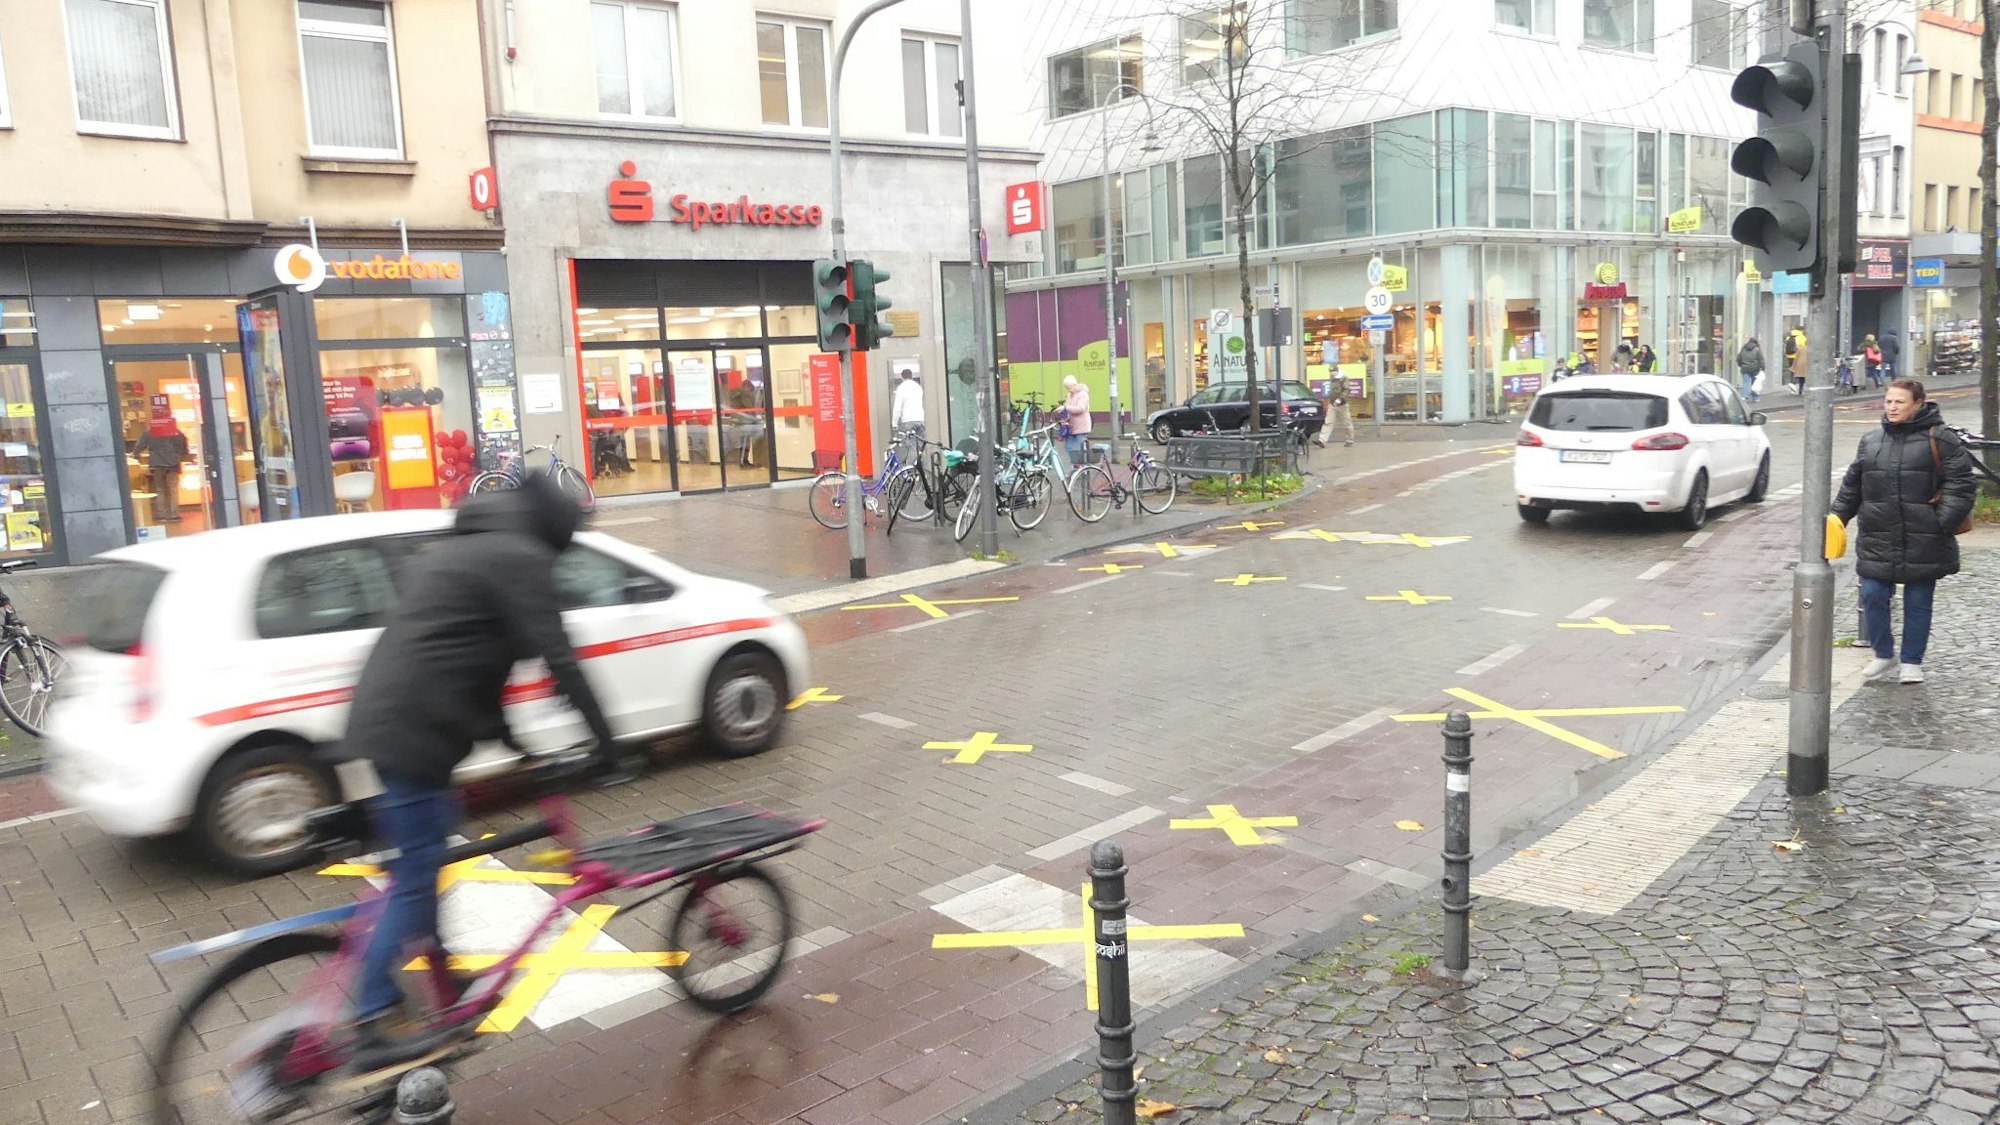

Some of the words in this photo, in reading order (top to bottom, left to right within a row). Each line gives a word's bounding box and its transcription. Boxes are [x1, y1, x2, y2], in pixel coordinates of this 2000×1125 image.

[672, 194, 823, 232] Sparkasse
[331, 253, 462, 280] vodafone
[1371, 294, 1387, 307] 30
